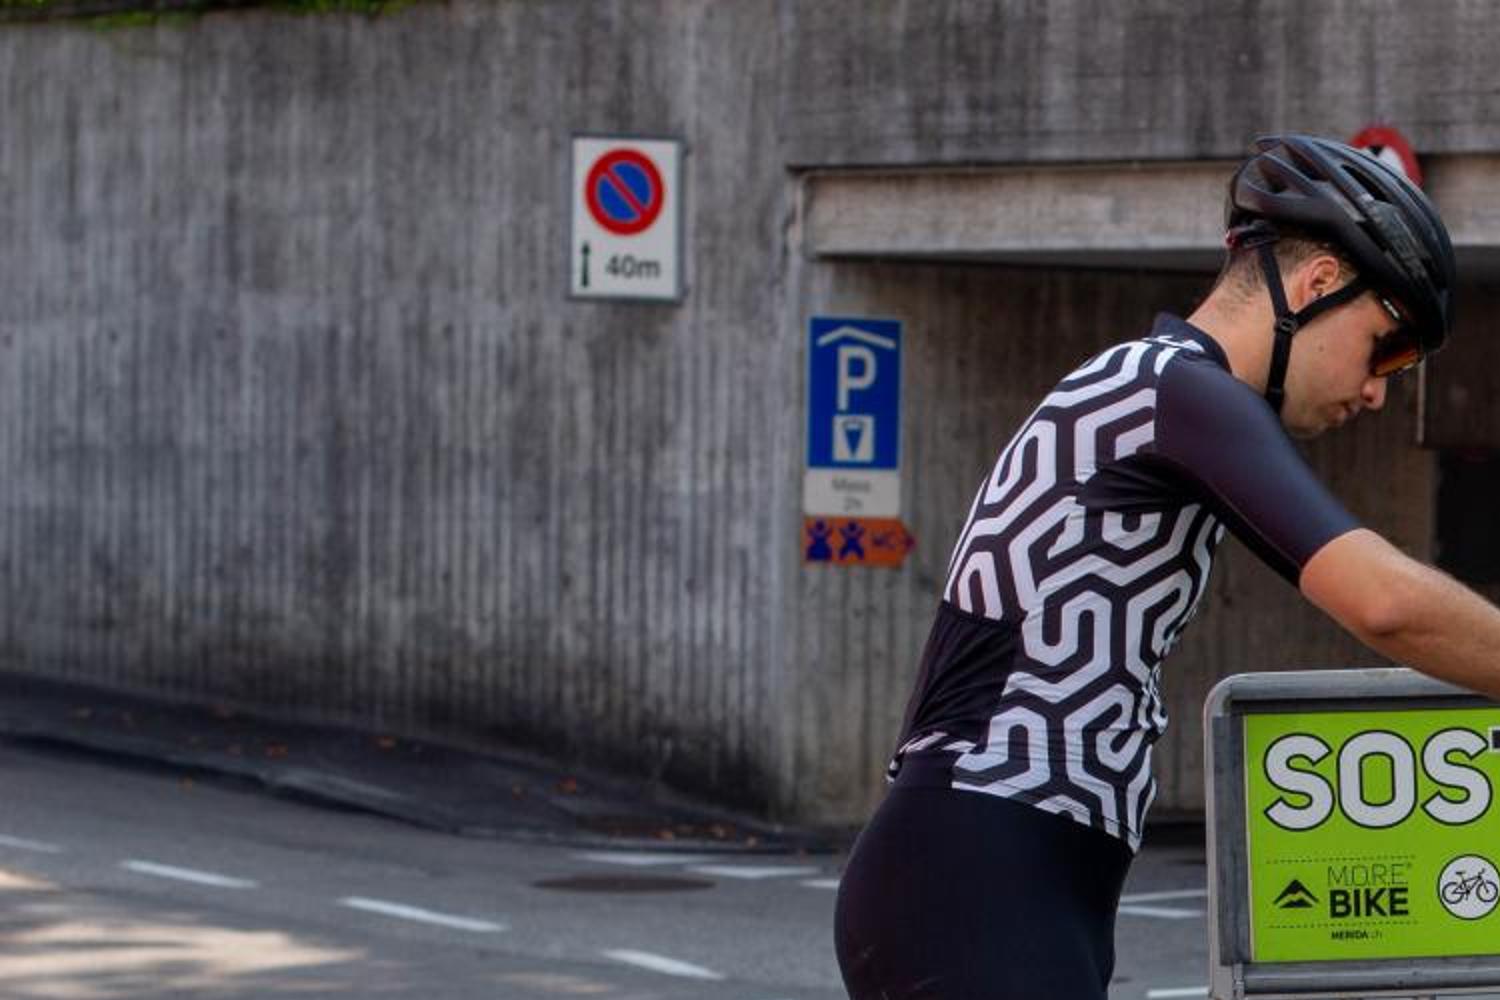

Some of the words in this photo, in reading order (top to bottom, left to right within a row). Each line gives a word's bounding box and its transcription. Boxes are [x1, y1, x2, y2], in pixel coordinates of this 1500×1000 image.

[606, 254, 662, 279] 40m
[836, 345, 877, 411] P
[1330, 887, 1408, 918] BIKE
